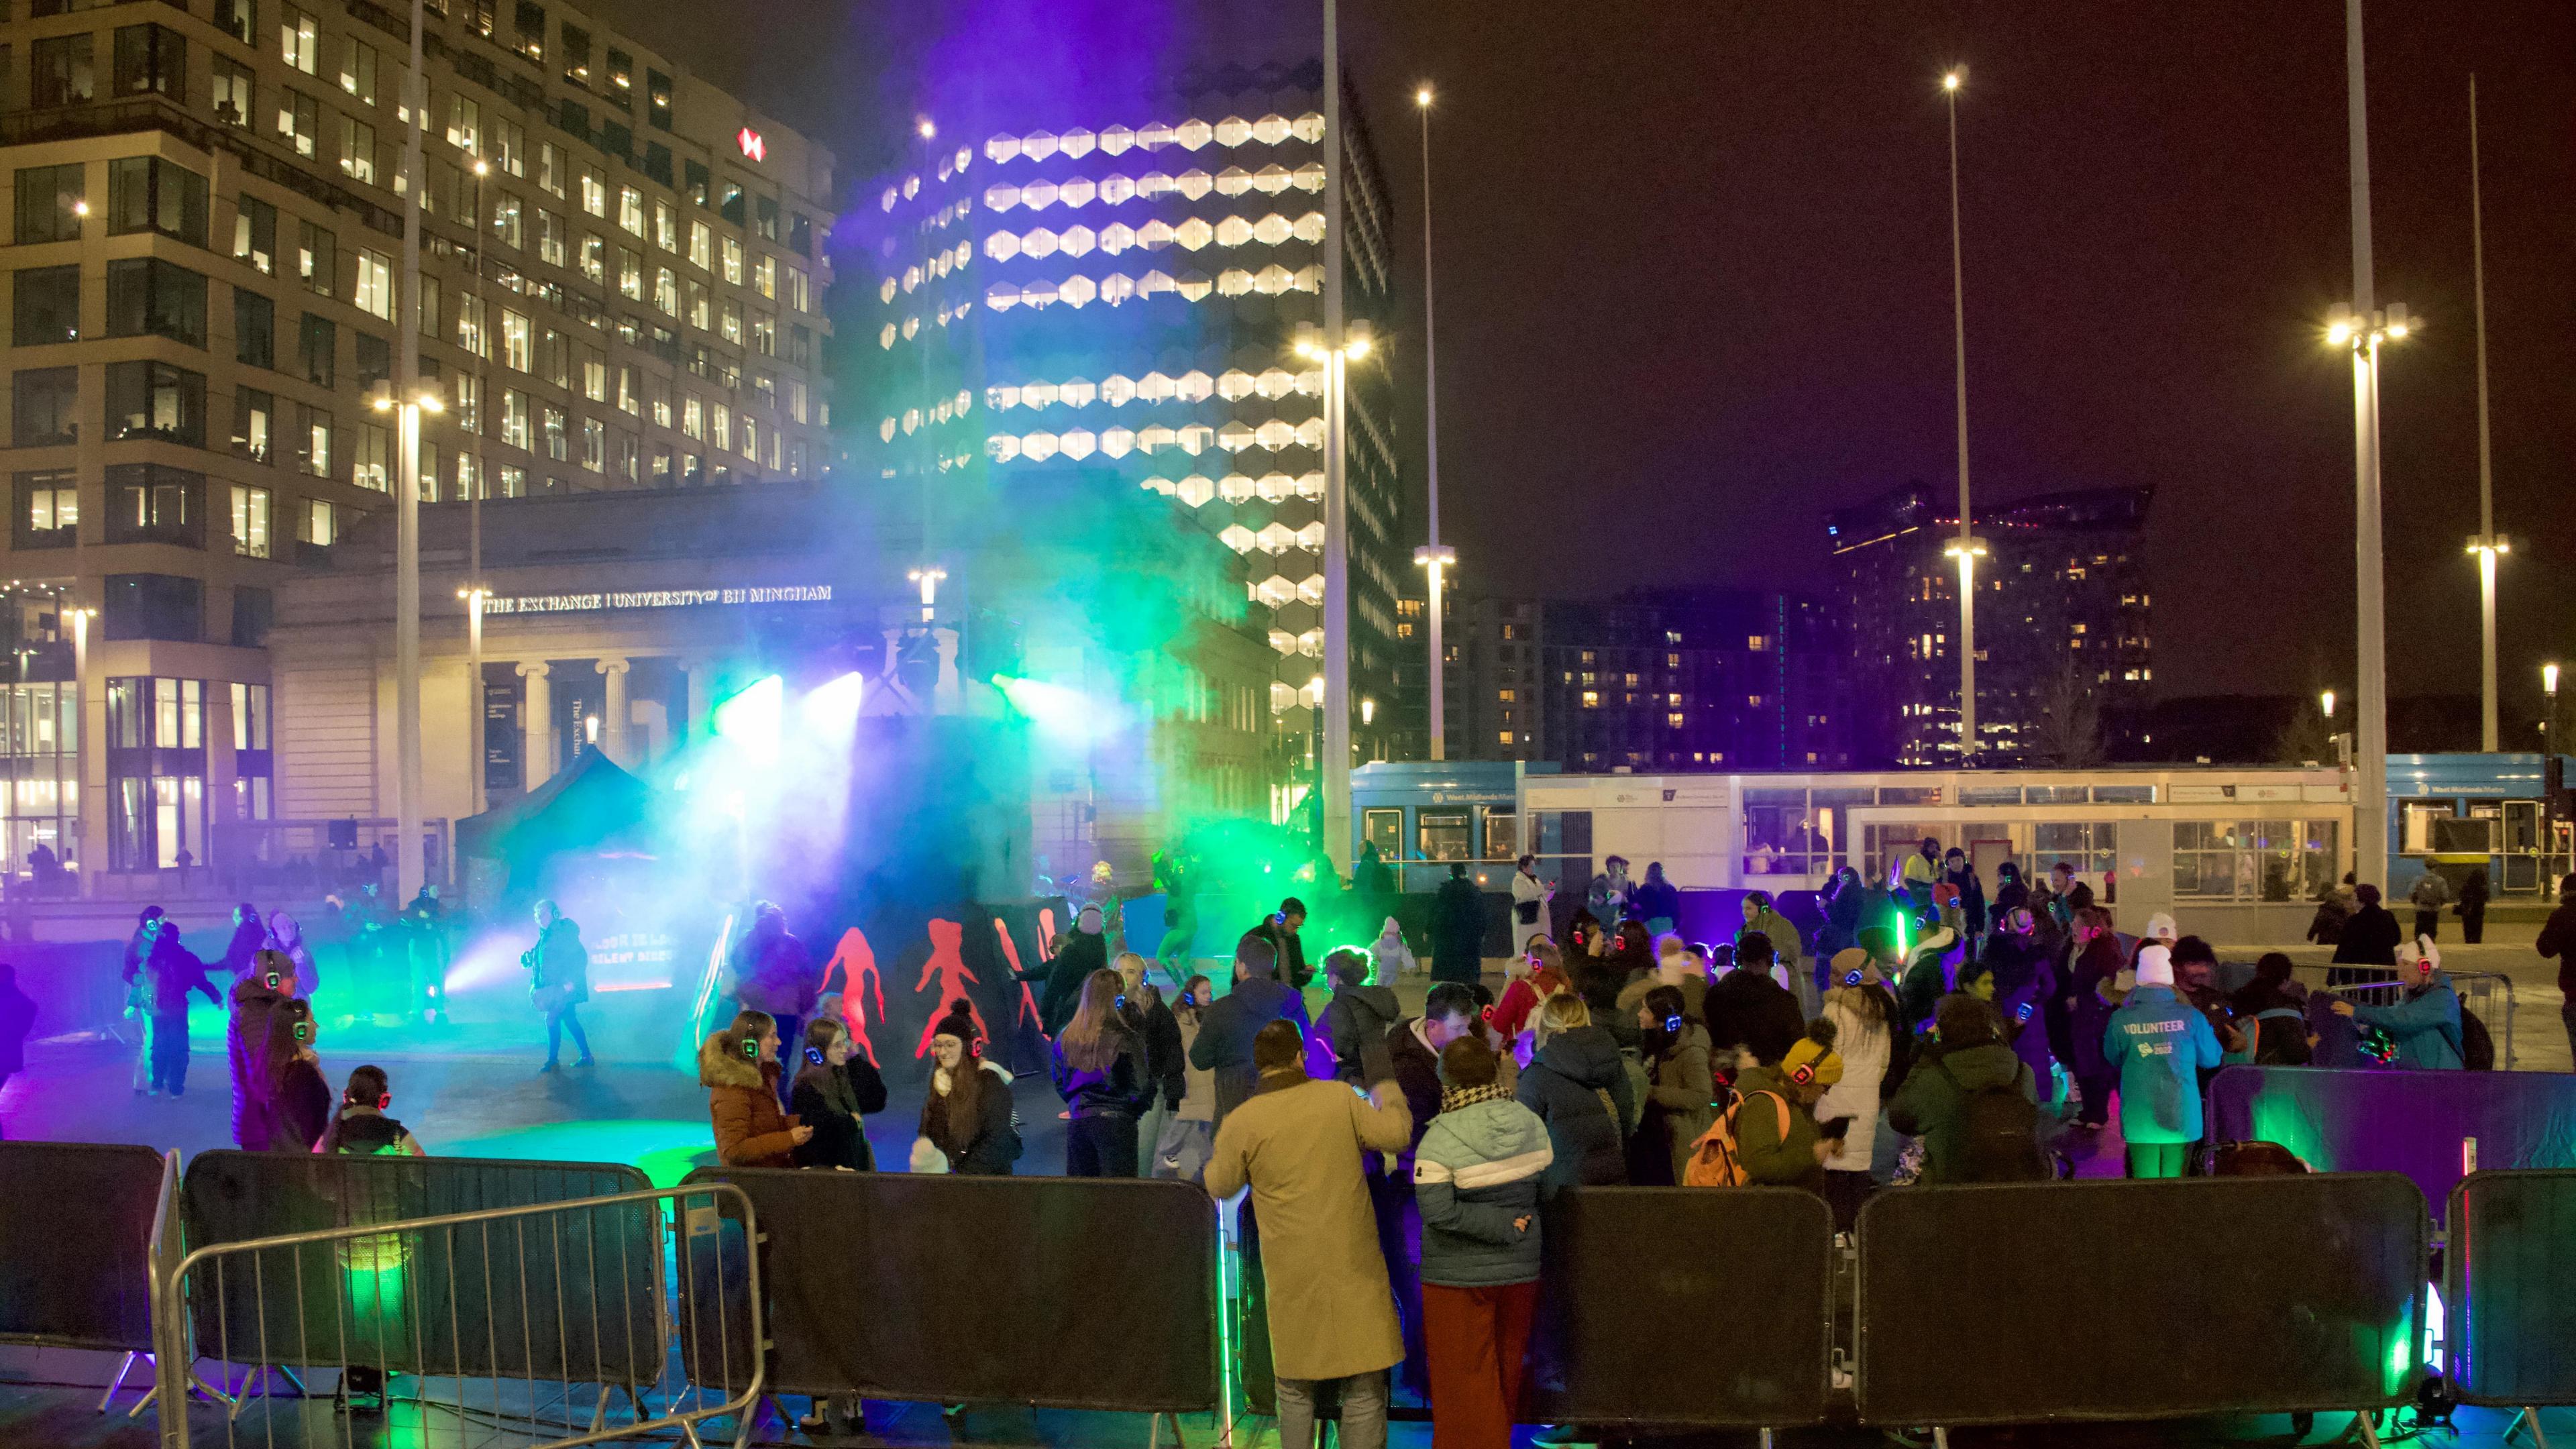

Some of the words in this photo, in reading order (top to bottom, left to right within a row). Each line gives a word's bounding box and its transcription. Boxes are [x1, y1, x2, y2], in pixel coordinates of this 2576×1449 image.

[483, 598, 515, 614] THE
[518, 594, 602, 612] EXCHANGE
[613, 590, 706, 607] UNIVERSITY
[573, 698, 583, 719] The
[1466, 793, 1497, 801] Midlands
[1499, 792, 1515, 801] Metr
[2123, 1020, 2184, 1034] VOLUNTEER
